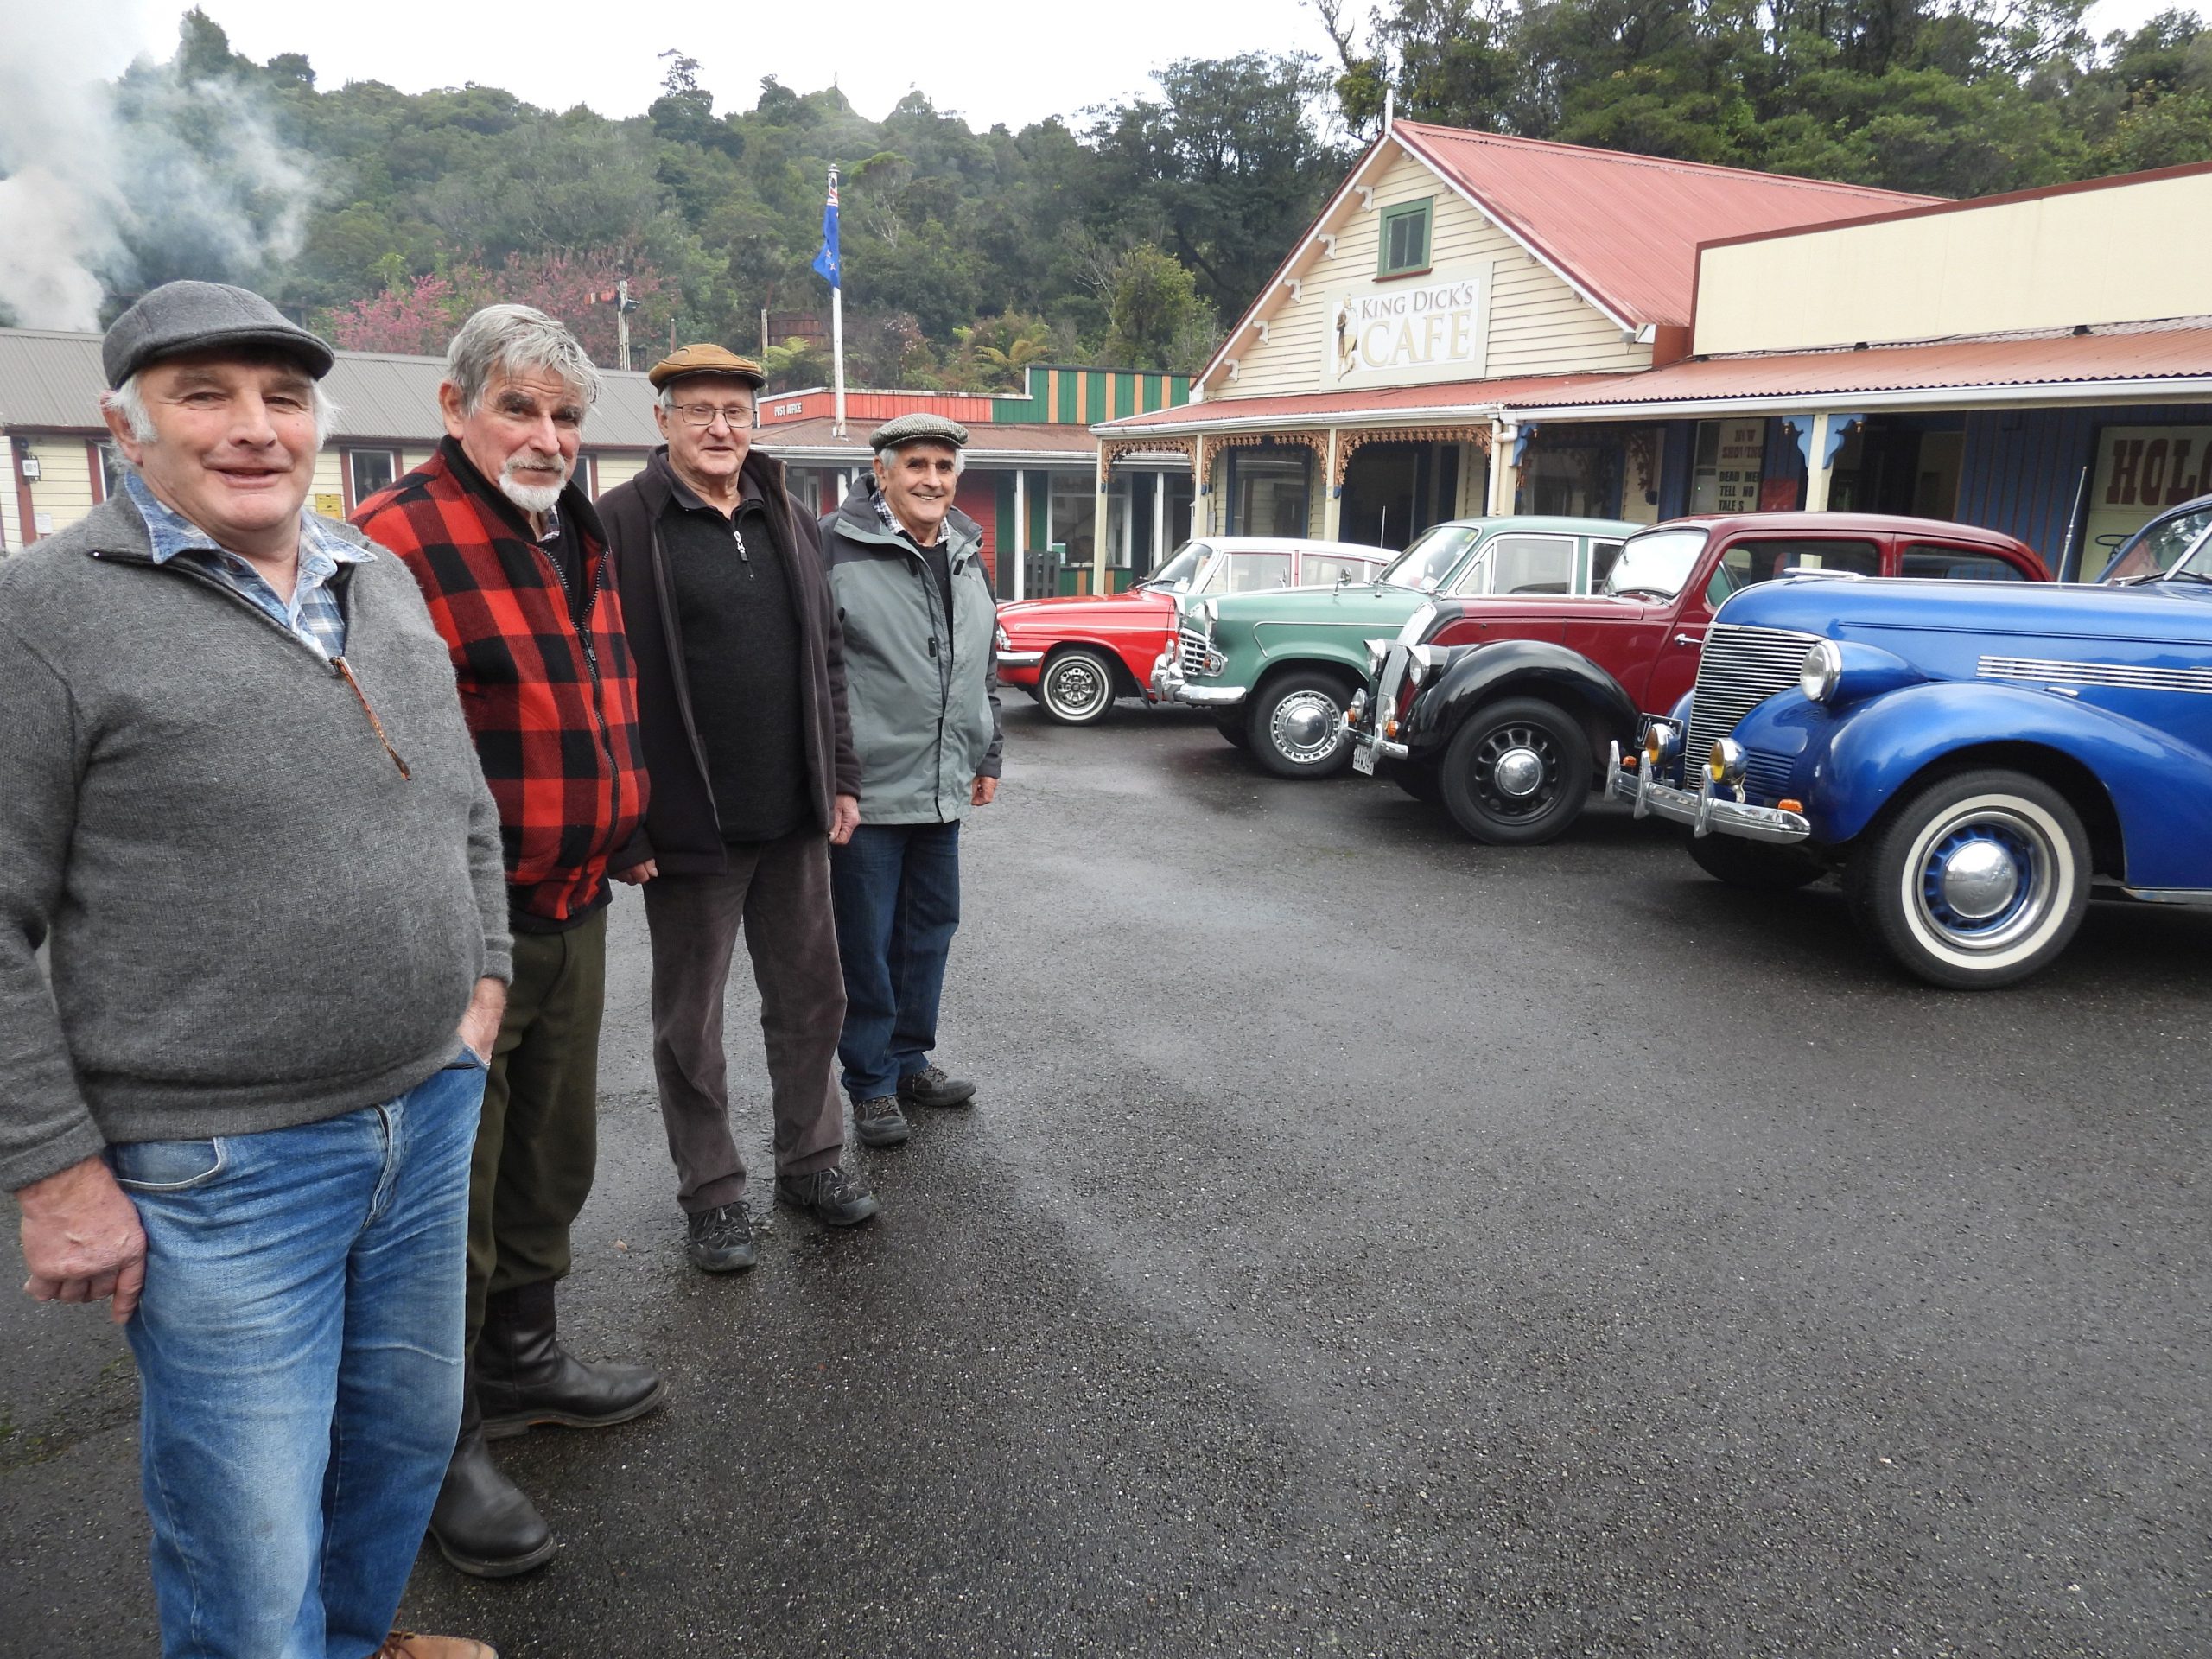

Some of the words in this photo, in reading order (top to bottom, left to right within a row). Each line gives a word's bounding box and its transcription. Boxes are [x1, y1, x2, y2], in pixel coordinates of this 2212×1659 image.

[1362, 309, 1471, 367] CAFE
[774, 405, 785, 416] POST
[786, 402, 802, 415] OFFICE
[1719, 471, 1739, 482] DEAD
[1719, 486, 1736, 497] TELL
[1742, 486, 1754, 498] NO
